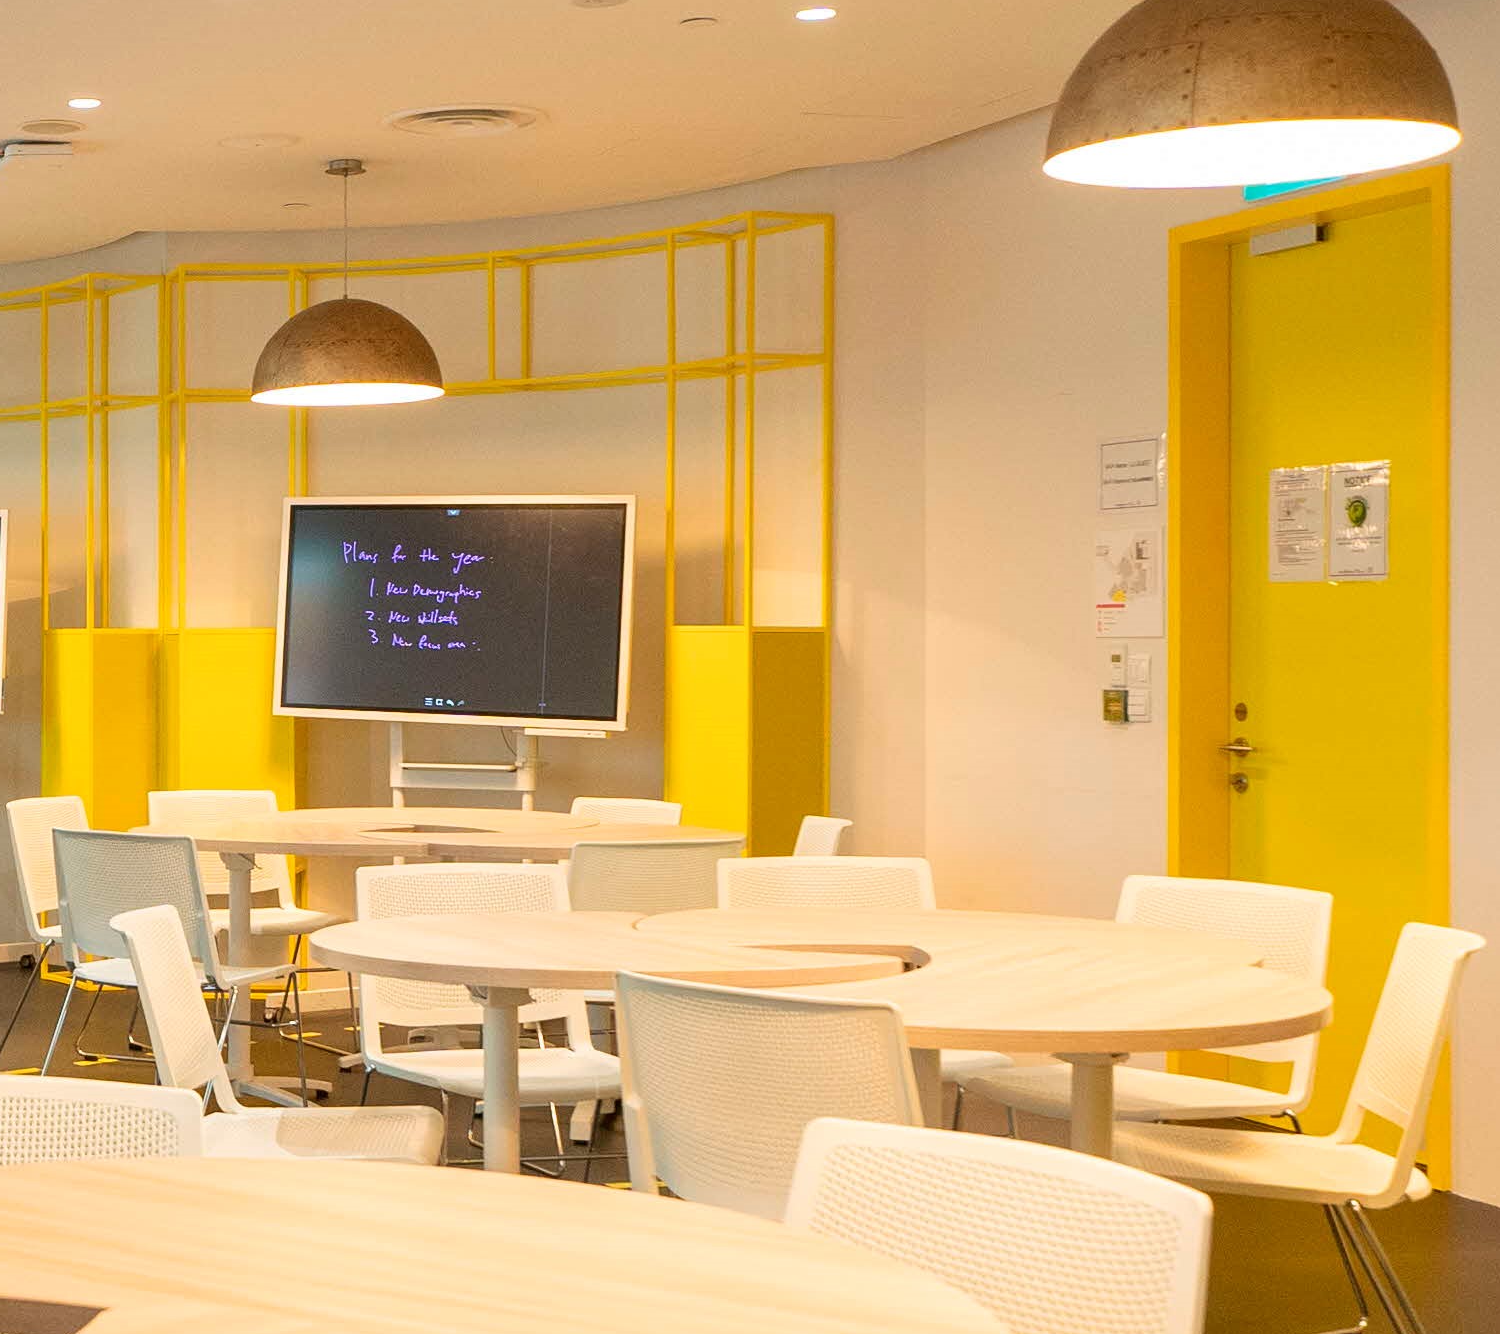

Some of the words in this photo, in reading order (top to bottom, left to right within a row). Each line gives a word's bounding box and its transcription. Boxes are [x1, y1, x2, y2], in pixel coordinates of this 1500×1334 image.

[343, 540, 379, 564] Plans
[391, 544, 407, 564] for
[419, 547, 440, 562] the
[386, 581, 408, 597] New
[412, 583, 482, 604] Demographics
[388, 610, 410, 624] New
[392, 633, 413, 647] New
